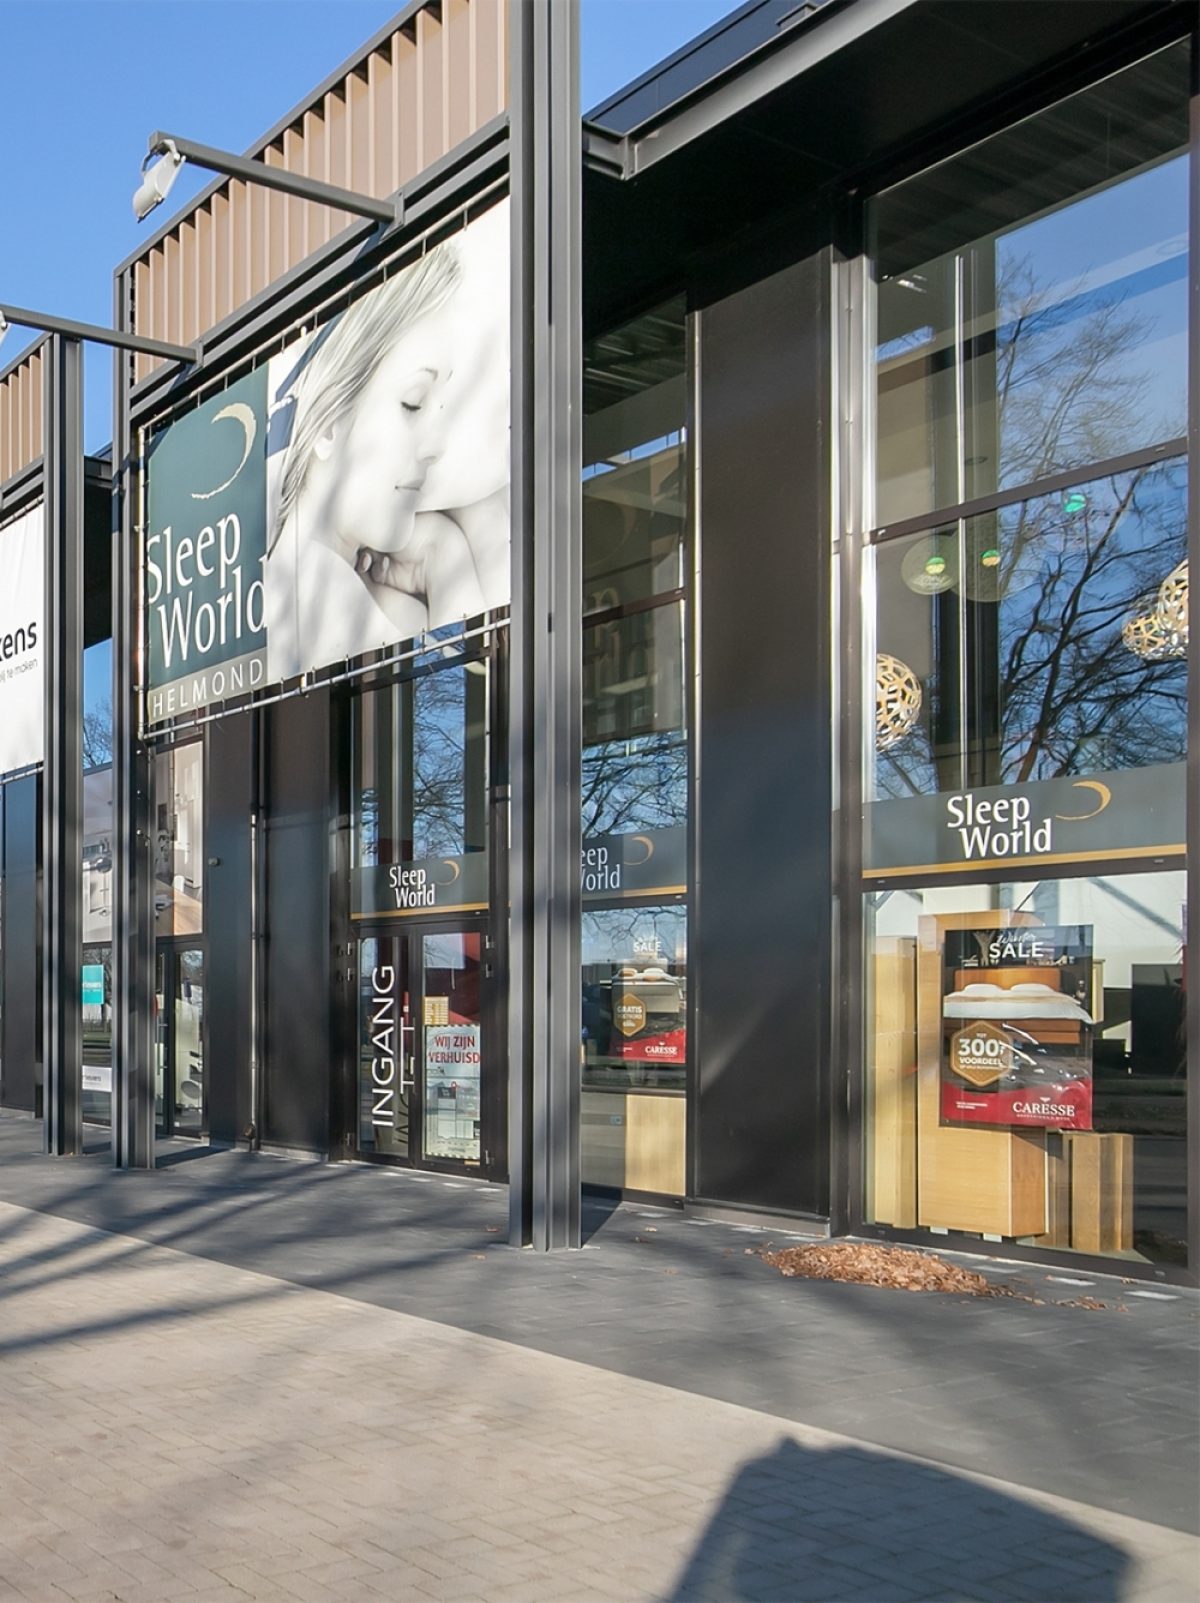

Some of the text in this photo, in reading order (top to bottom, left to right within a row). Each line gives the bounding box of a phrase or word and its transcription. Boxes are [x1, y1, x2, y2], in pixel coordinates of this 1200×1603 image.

[146, 513, 241, 604] Sleep
[157, 553, 269, 668] World
[152, 658, 263, 717] HELMOND
[947, 793, 1030, 830] Sleep
[959, 818, 1051, 859] World
[389, 866, 426, 889] Sleep
[581, 863, 620, 891] orld
[395, 883, 435, 908] World
[633, 941, 663, 952] SALE
[989, 942, 1045, 958] SALE
[372, 965, 395, 1127] INGANG
[434, 1036, 475, 1050] WIJ ZIJN
[429, 1051, 480, 1064] VERHUISD
[1012, 1101, 1075, 1117] CARESSE
